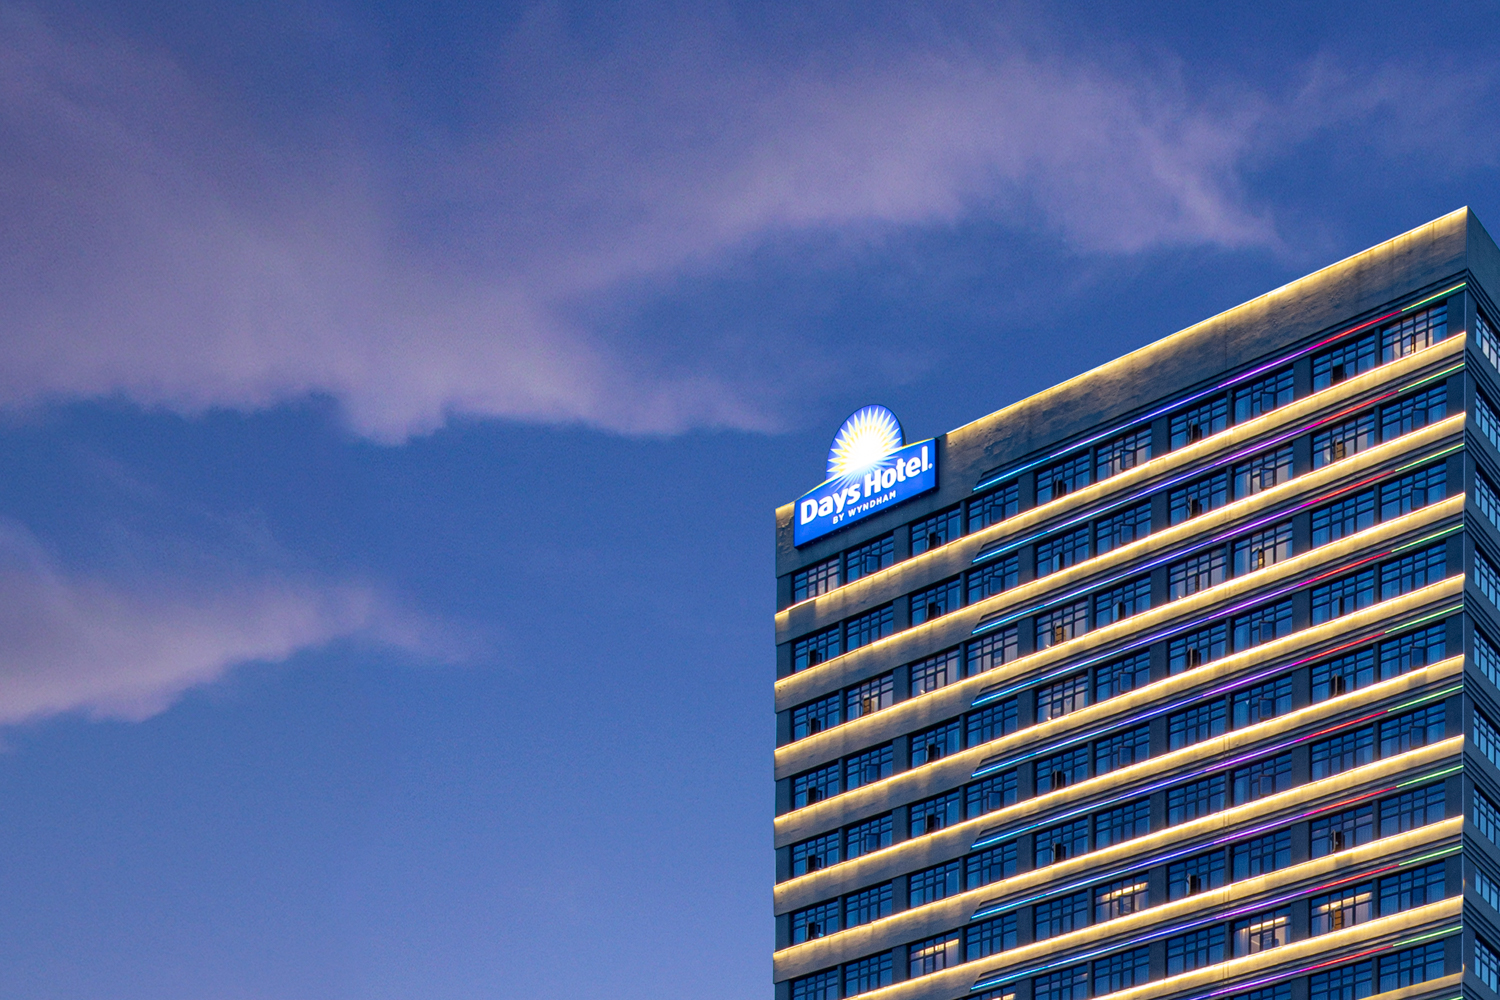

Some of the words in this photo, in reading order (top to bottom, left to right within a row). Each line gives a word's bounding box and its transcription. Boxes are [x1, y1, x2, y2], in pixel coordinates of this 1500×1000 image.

[800, 483, 861, 525] Days
[864, 445, 928, 497] Hotel
[832, 512, 845, 525] BY
[848, 490, 897, 518] WYNDHAM
